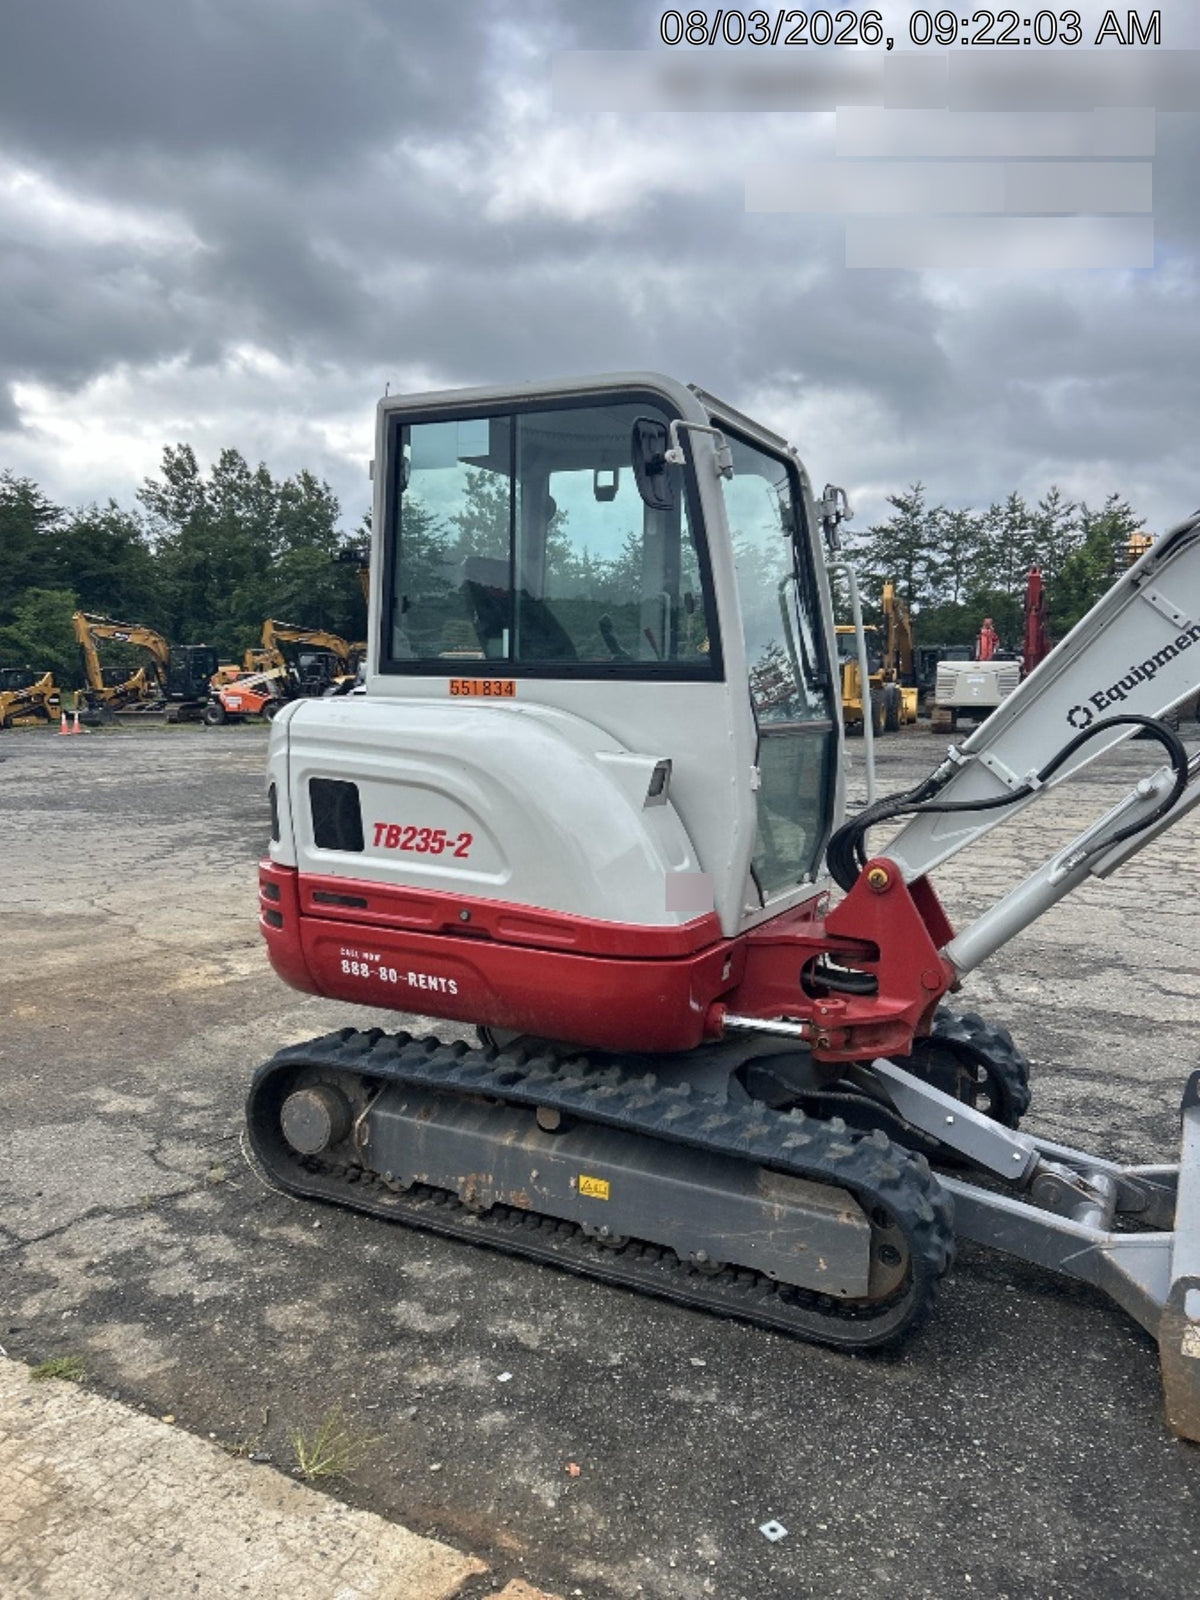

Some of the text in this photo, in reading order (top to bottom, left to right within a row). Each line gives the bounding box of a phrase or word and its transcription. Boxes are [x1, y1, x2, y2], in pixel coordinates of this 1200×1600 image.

[449, 680, 513, 696] 551834
[373, 822, 473, 858] TB235-2
[341, 959, 458, 994] 888-80-RENTS
